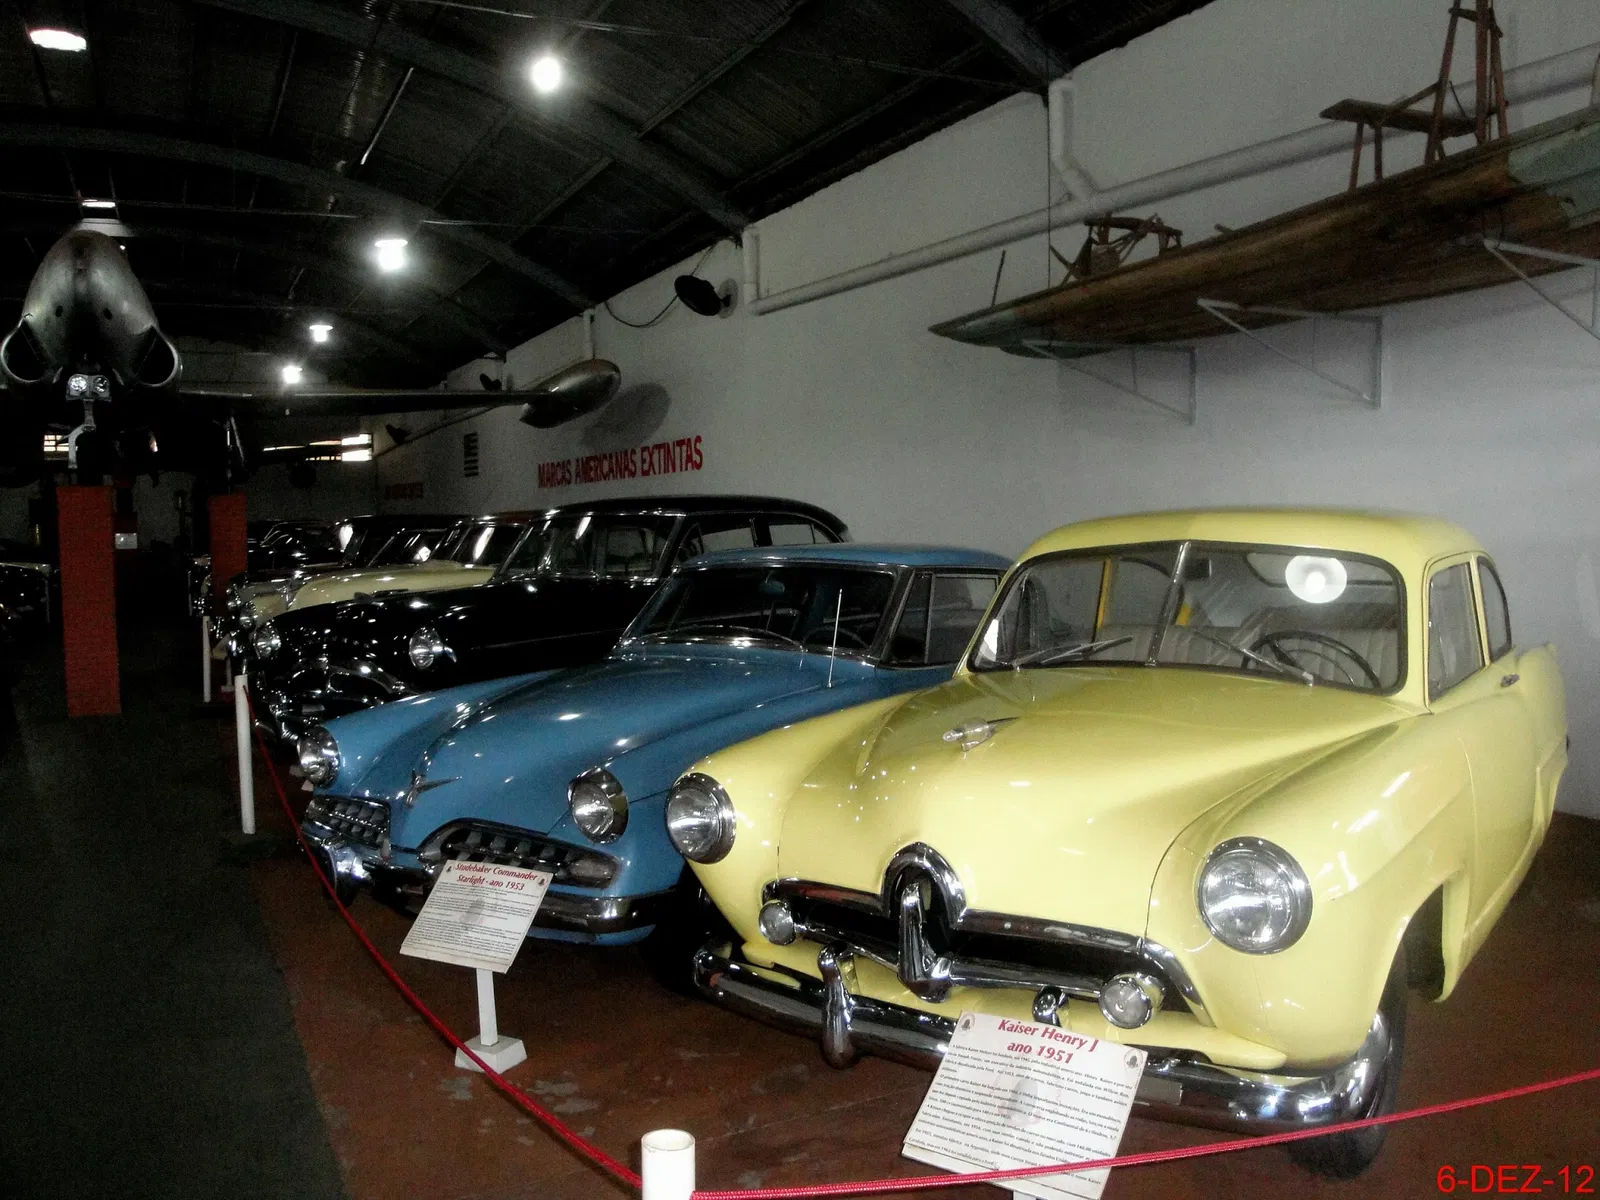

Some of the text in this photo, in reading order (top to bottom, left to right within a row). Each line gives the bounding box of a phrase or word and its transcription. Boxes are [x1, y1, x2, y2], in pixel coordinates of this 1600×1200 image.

[538, 435, 703, 488] MARCAS AMERICANAS EXTINTAS
[455, 863, 538, 881] Studebaker Commander
[457, 875, 485, 885] Starlight
[505, 881, 525, 891] 1953
[998, 1018, 1099, 1052] Kaiser Henry J
[1007, 1041, 1032, 1055] ano
[1037, 1044, 1075, 1064] 1951
